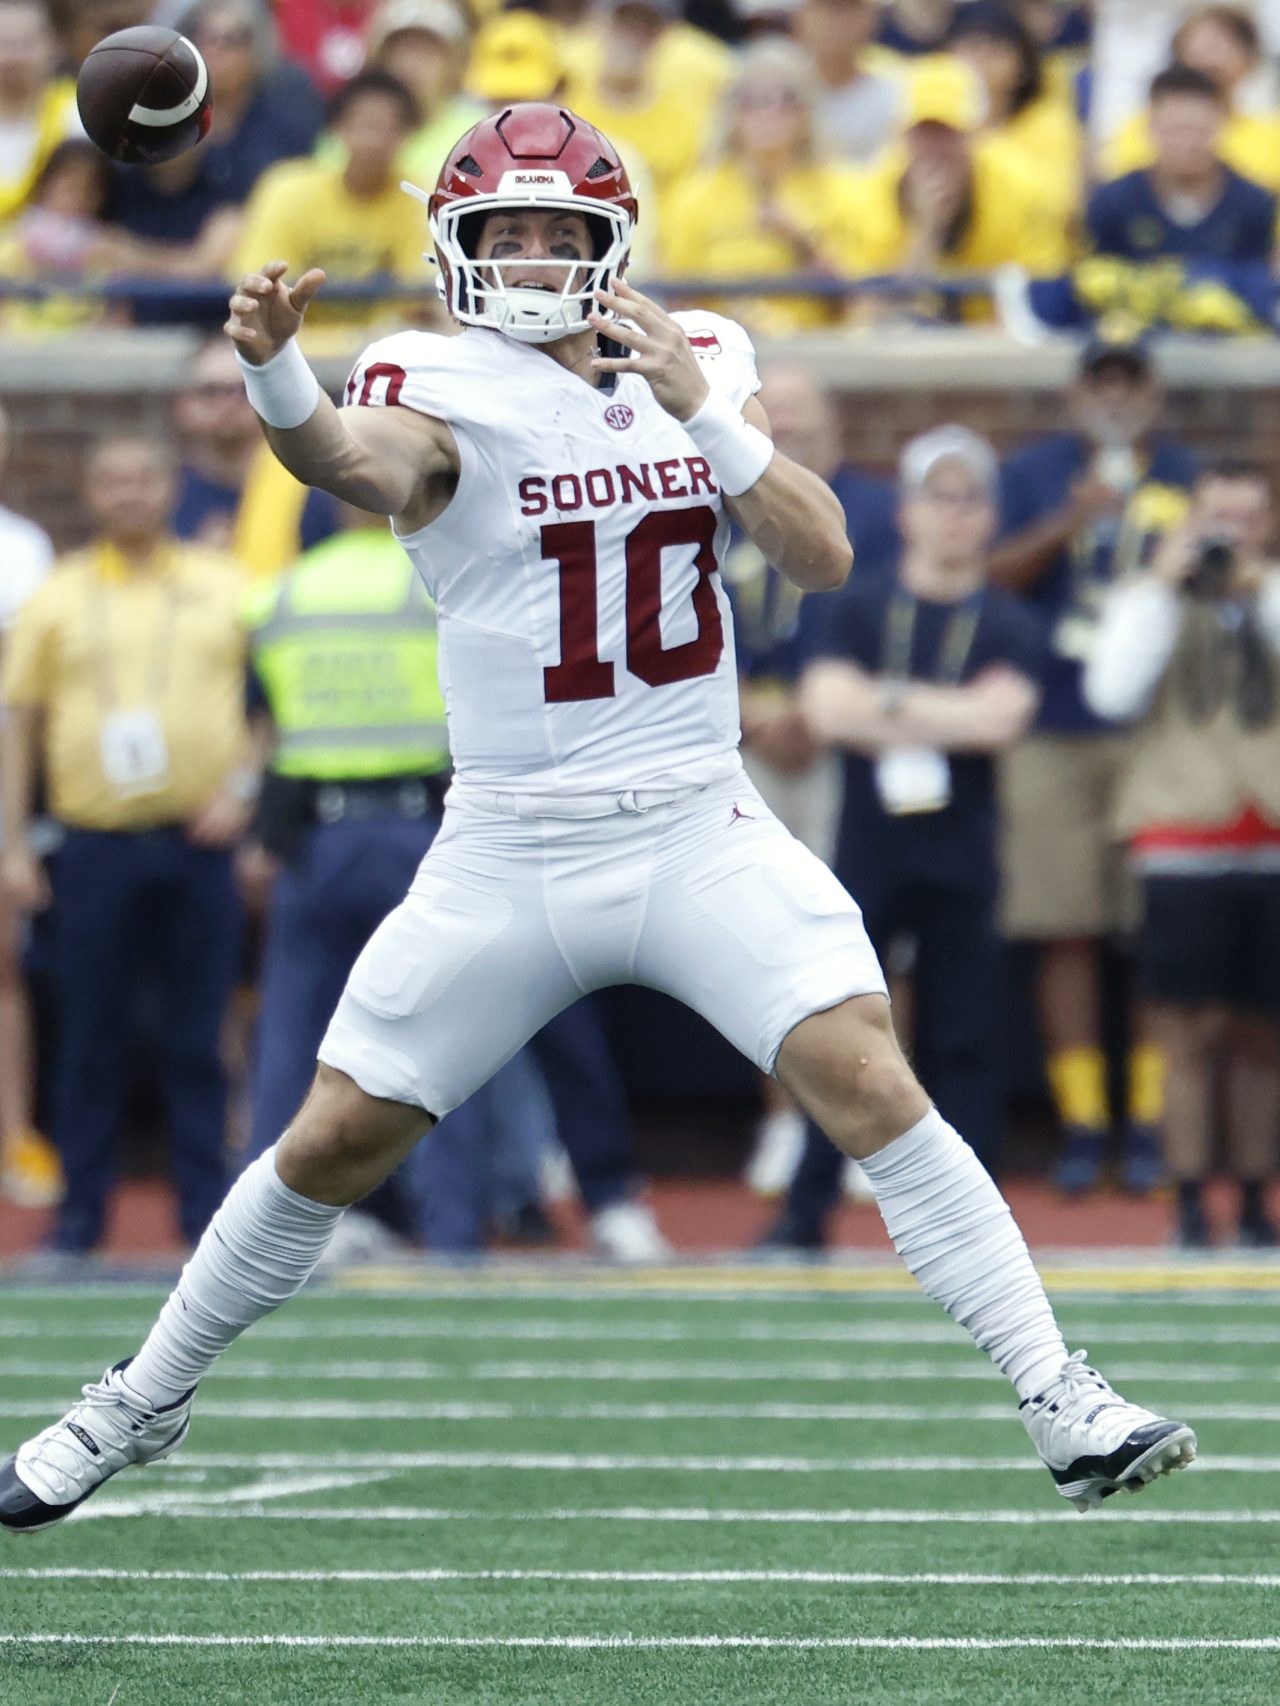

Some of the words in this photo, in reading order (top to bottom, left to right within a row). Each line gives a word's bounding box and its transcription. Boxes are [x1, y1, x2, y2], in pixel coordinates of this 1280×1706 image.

[515, 175, 554, 183] OKLAHOMA
[606, 406, 634, 429] SEC
[540, 505, 724, 703] 10
